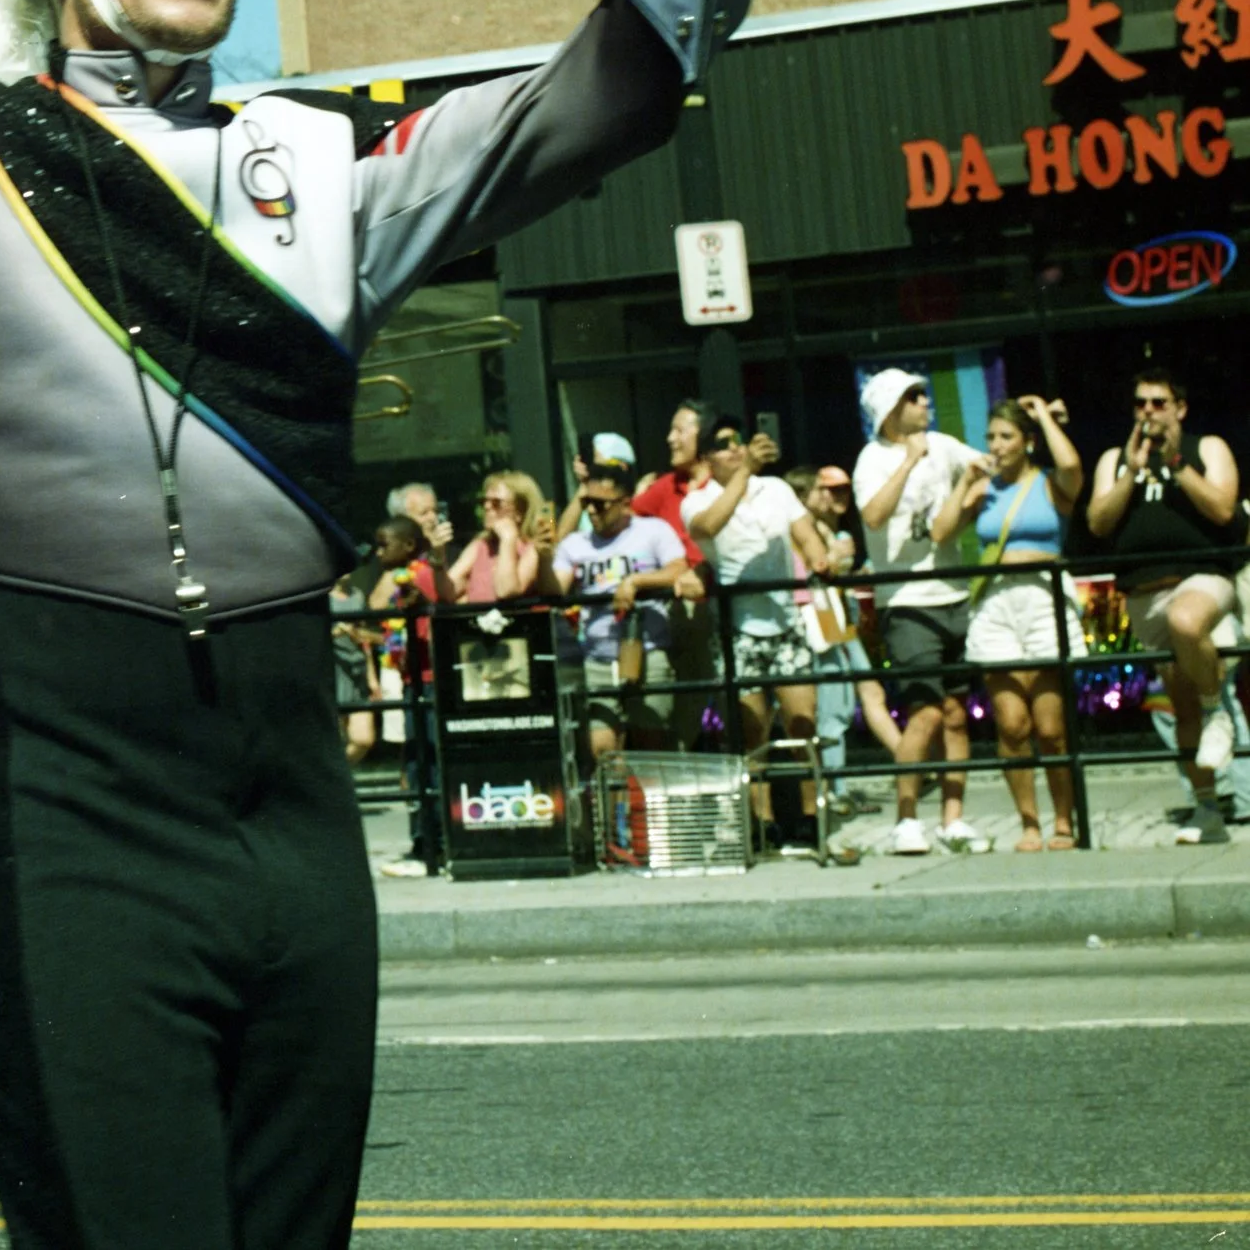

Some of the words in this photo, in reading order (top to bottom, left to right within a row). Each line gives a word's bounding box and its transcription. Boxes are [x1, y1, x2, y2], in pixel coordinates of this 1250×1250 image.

[902, 134, 1003, 209] DA
[1023, 107, 1231, 195] HONG
[1107, 244, 1222, 296] OPEN
[461, 779, 554, 823] blade
